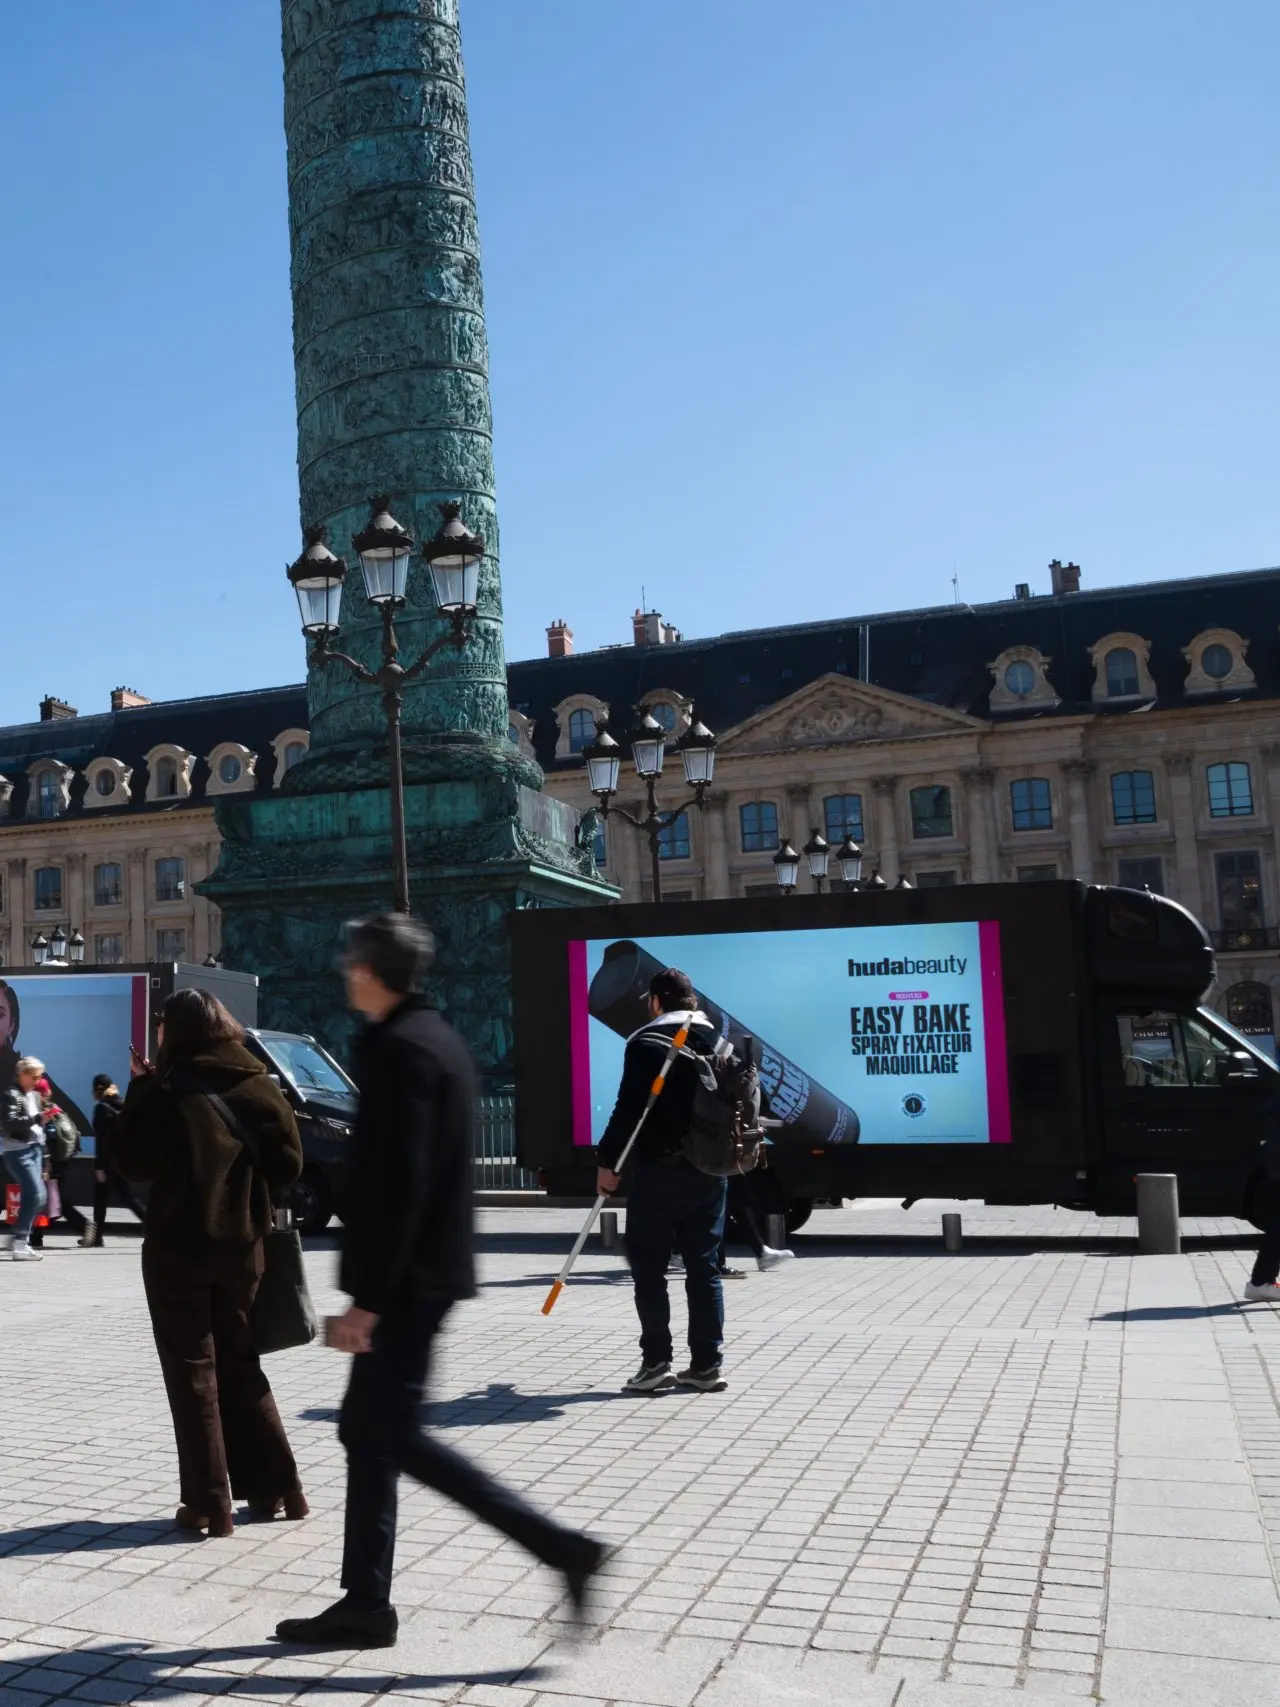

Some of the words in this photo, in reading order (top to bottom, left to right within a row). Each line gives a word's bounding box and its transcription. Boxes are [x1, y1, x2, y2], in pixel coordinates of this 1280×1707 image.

[848, 955, 967, 977] hudabeauty
[851, 1005, 904, 1035] EASY
[913, 1003, 971, 1032] BAKE
[851, 1036, 899, 1055] SPRAY
[902, 1033, 972, 1054] FIXATEUR
[760, 1044, 785, 1097] ASY
[866, 1055, 959, 1075] MAQUILLAGE
